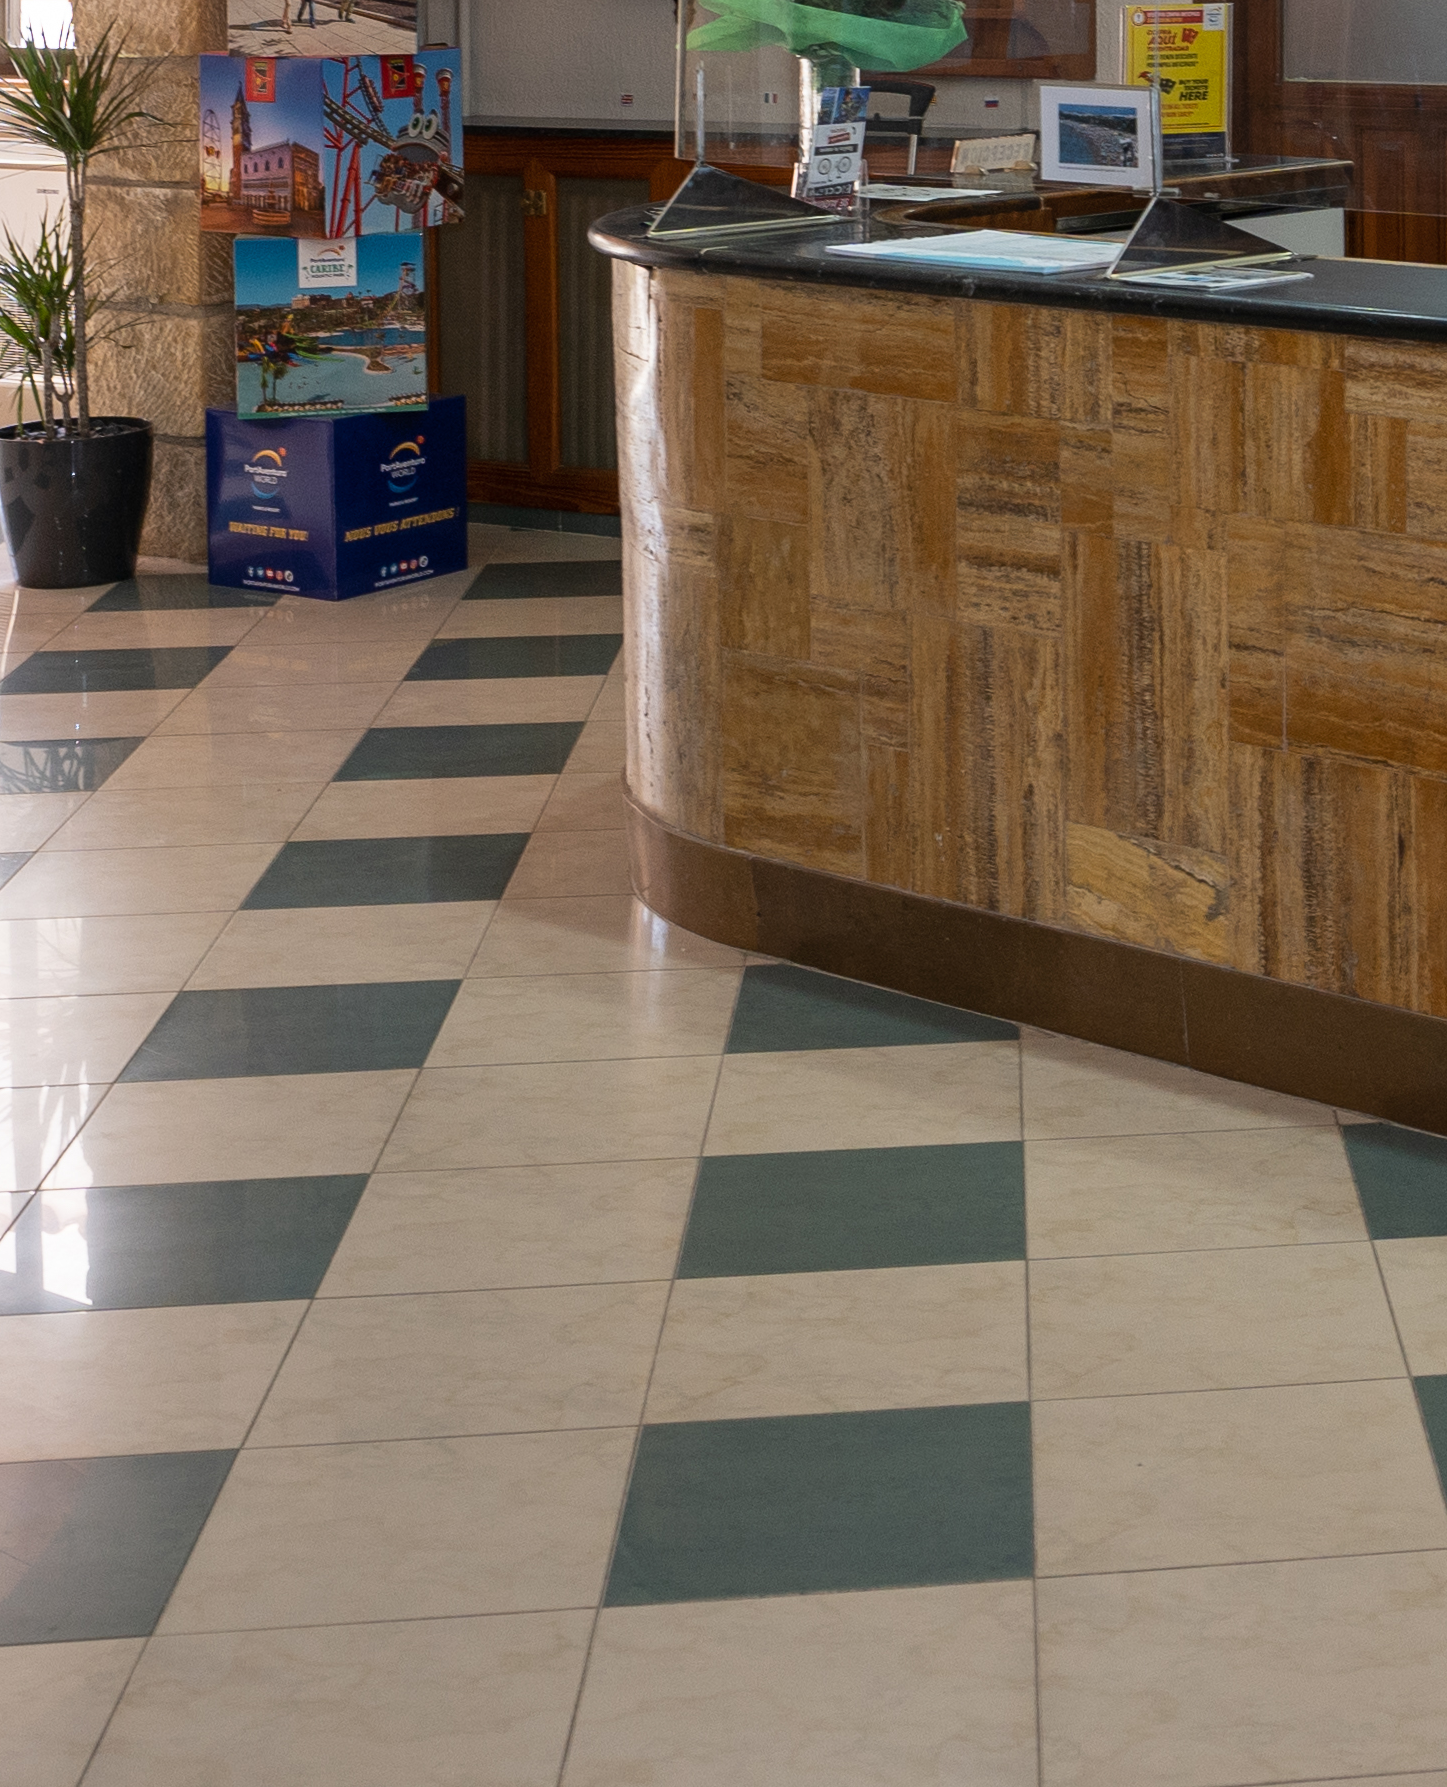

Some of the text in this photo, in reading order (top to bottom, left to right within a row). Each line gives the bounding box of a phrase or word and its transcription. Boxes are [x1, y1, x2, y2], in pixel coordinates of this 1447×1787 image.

[1179, 91, 1209, 101] HERE
[310, 264, 345, 274] CARIBE
[391, 467, 416, 478] WORLD
[344, 526, 372, 542] NOUS
[374, 520, 399, 536] VOUS
